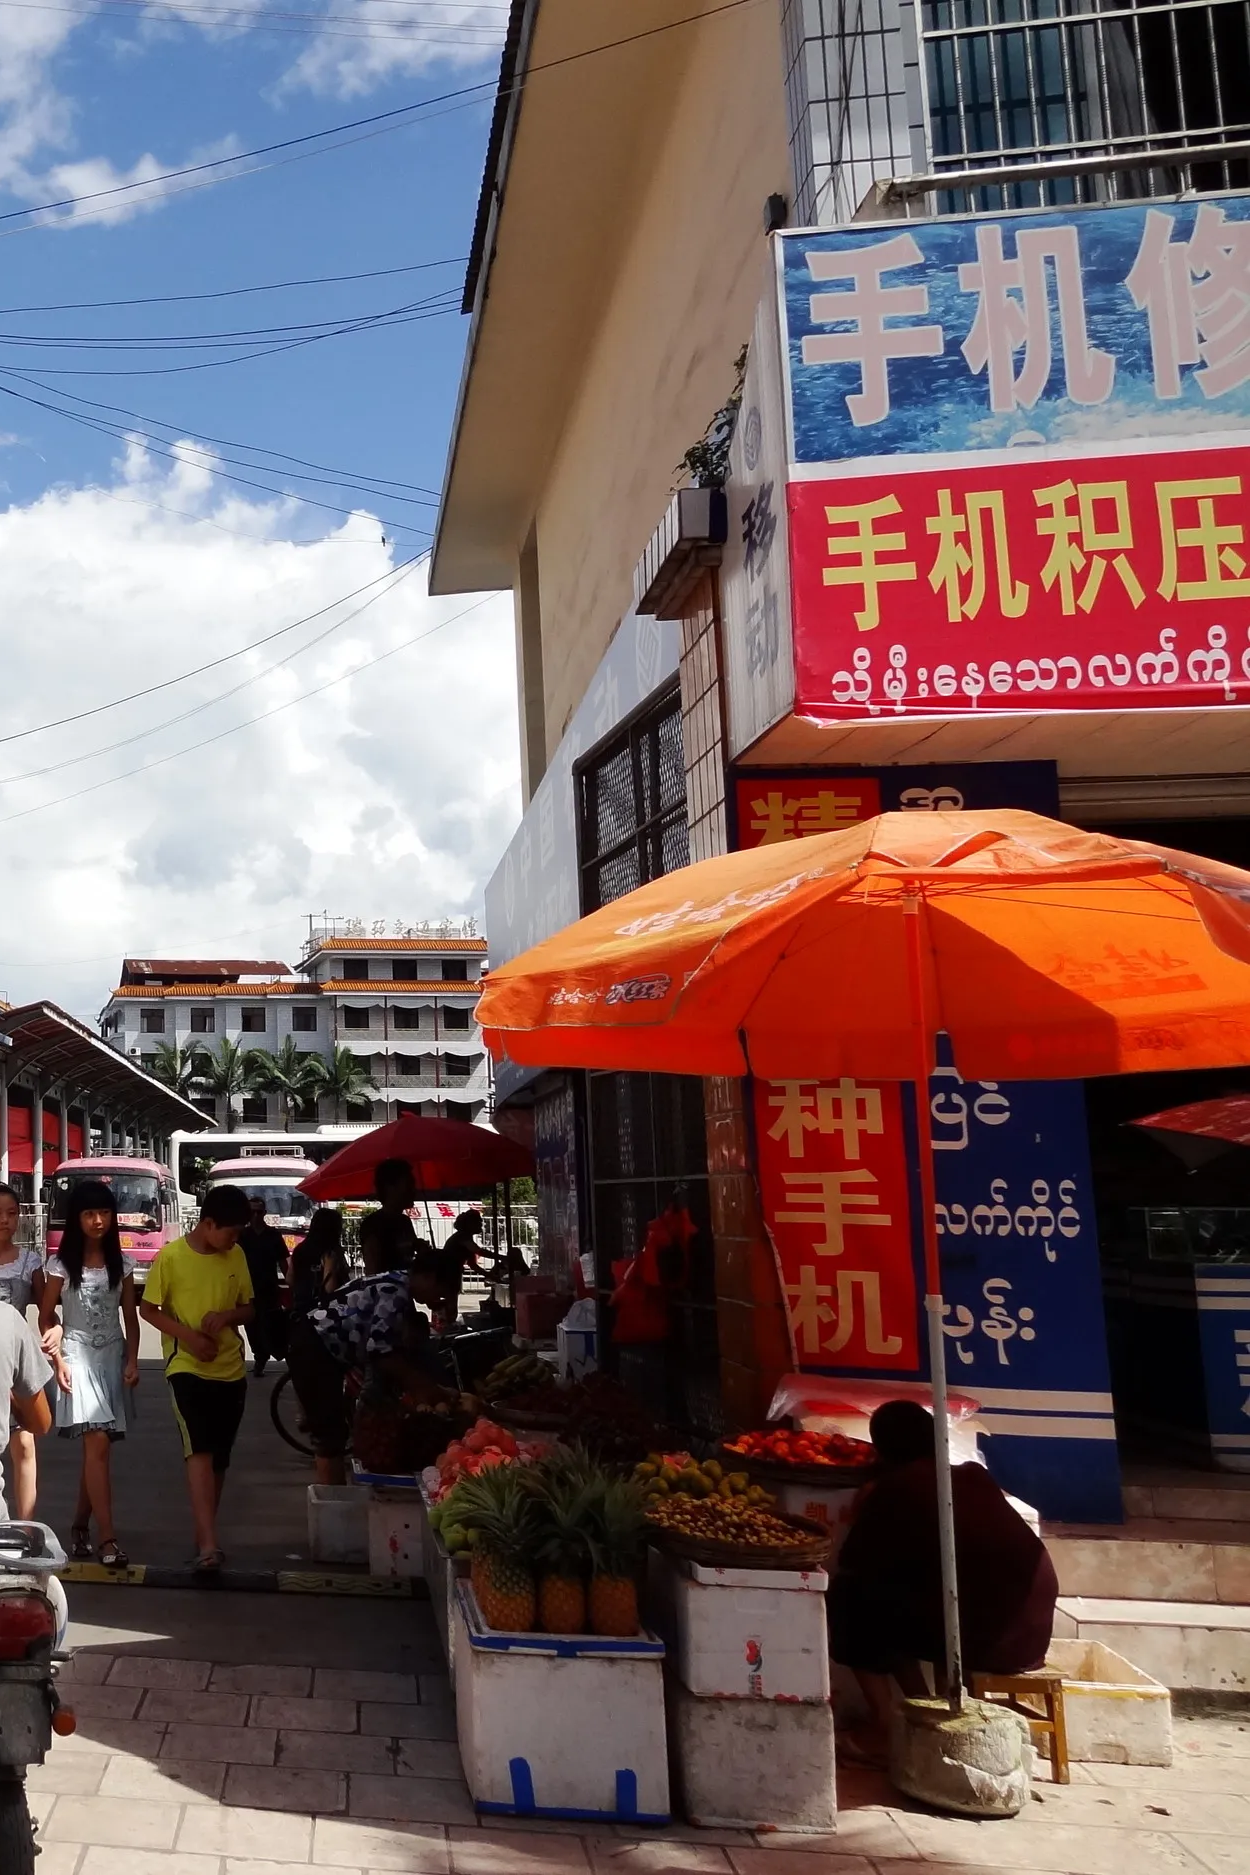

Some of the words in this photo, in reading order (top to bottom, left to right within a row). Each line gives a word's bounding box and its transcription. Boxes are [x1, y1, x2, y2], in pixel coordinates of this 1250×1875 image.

[801, 205, 1250, 427] 手机修
[823, 476, 1250, 632] 手机积压
[768, 1077, 902, 1355] 种手机
